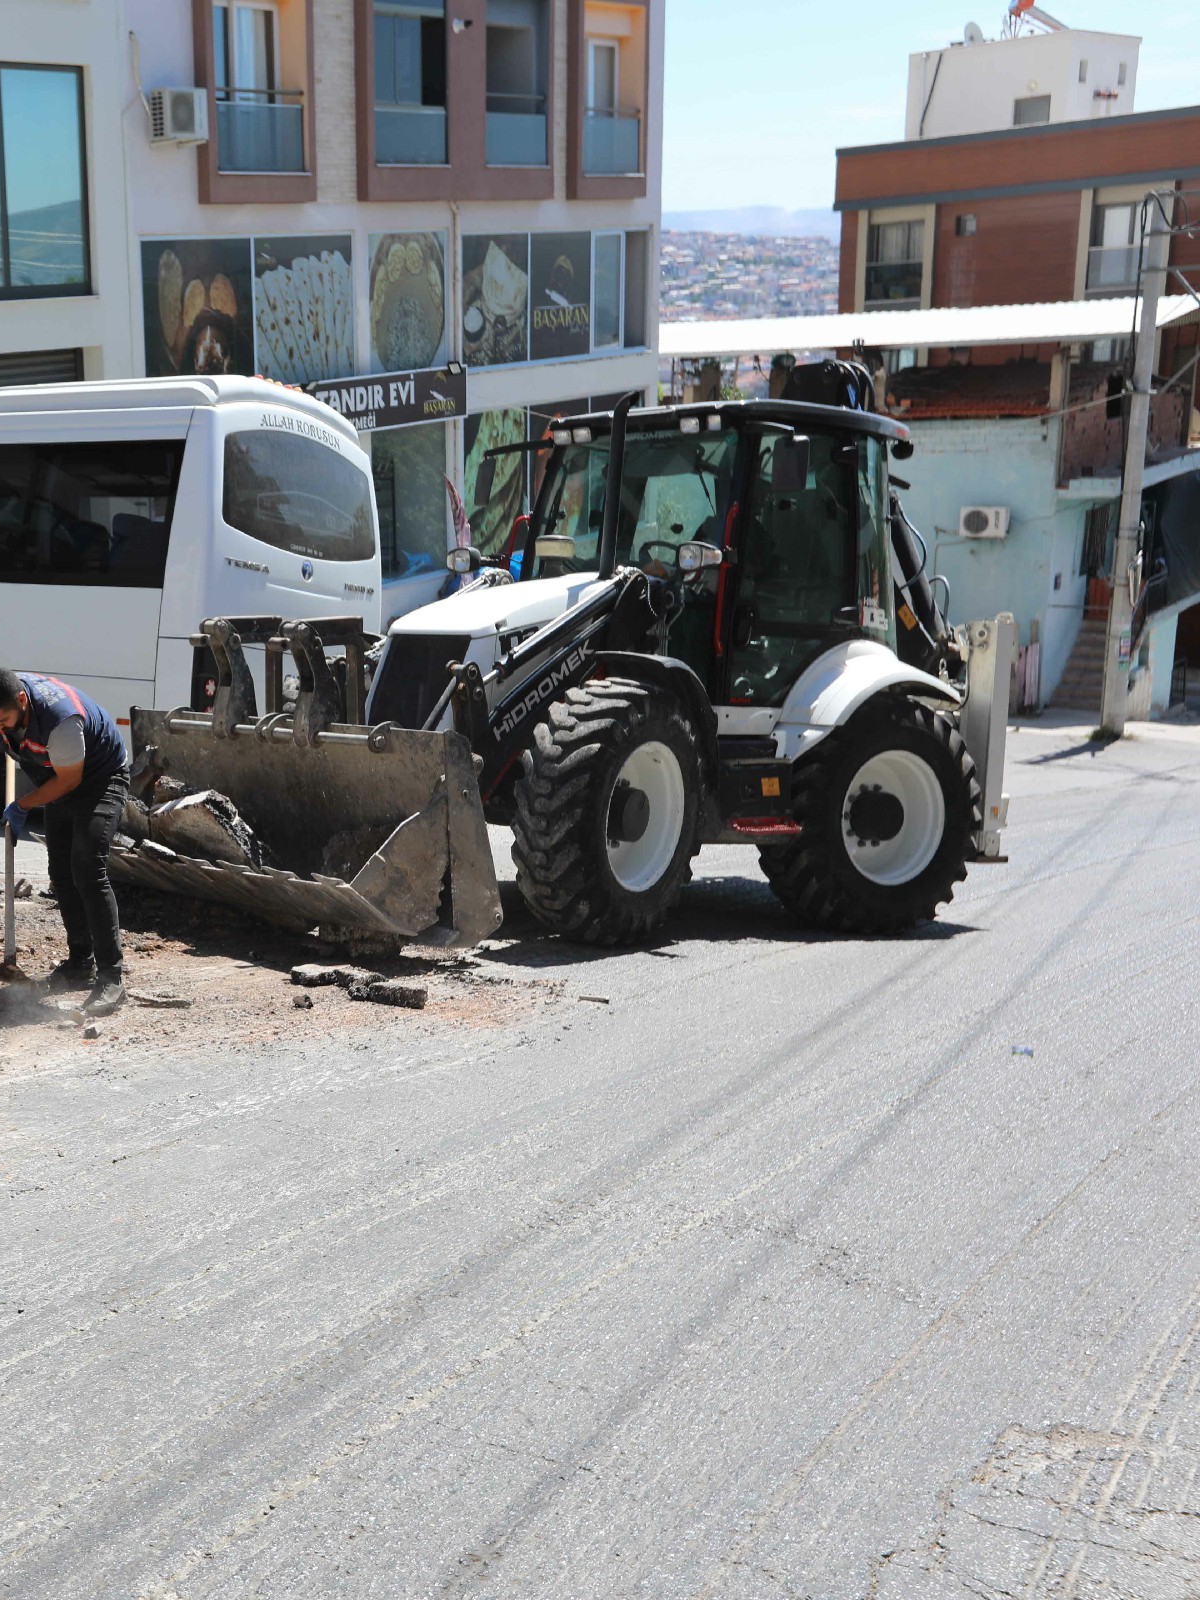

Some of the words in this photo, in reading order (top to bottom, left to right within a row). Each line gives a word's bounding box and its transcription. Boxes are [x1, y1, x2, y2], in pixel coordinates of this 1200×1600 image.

[533, 306, 589, 332] BAŞARAN
[315, 384, 385, 414] TANDIR
[389, 374, 415, 407] EVİ
[260, 414, 294, 430] ALLAH
[296, 420, 341, 450] KORUSUN
